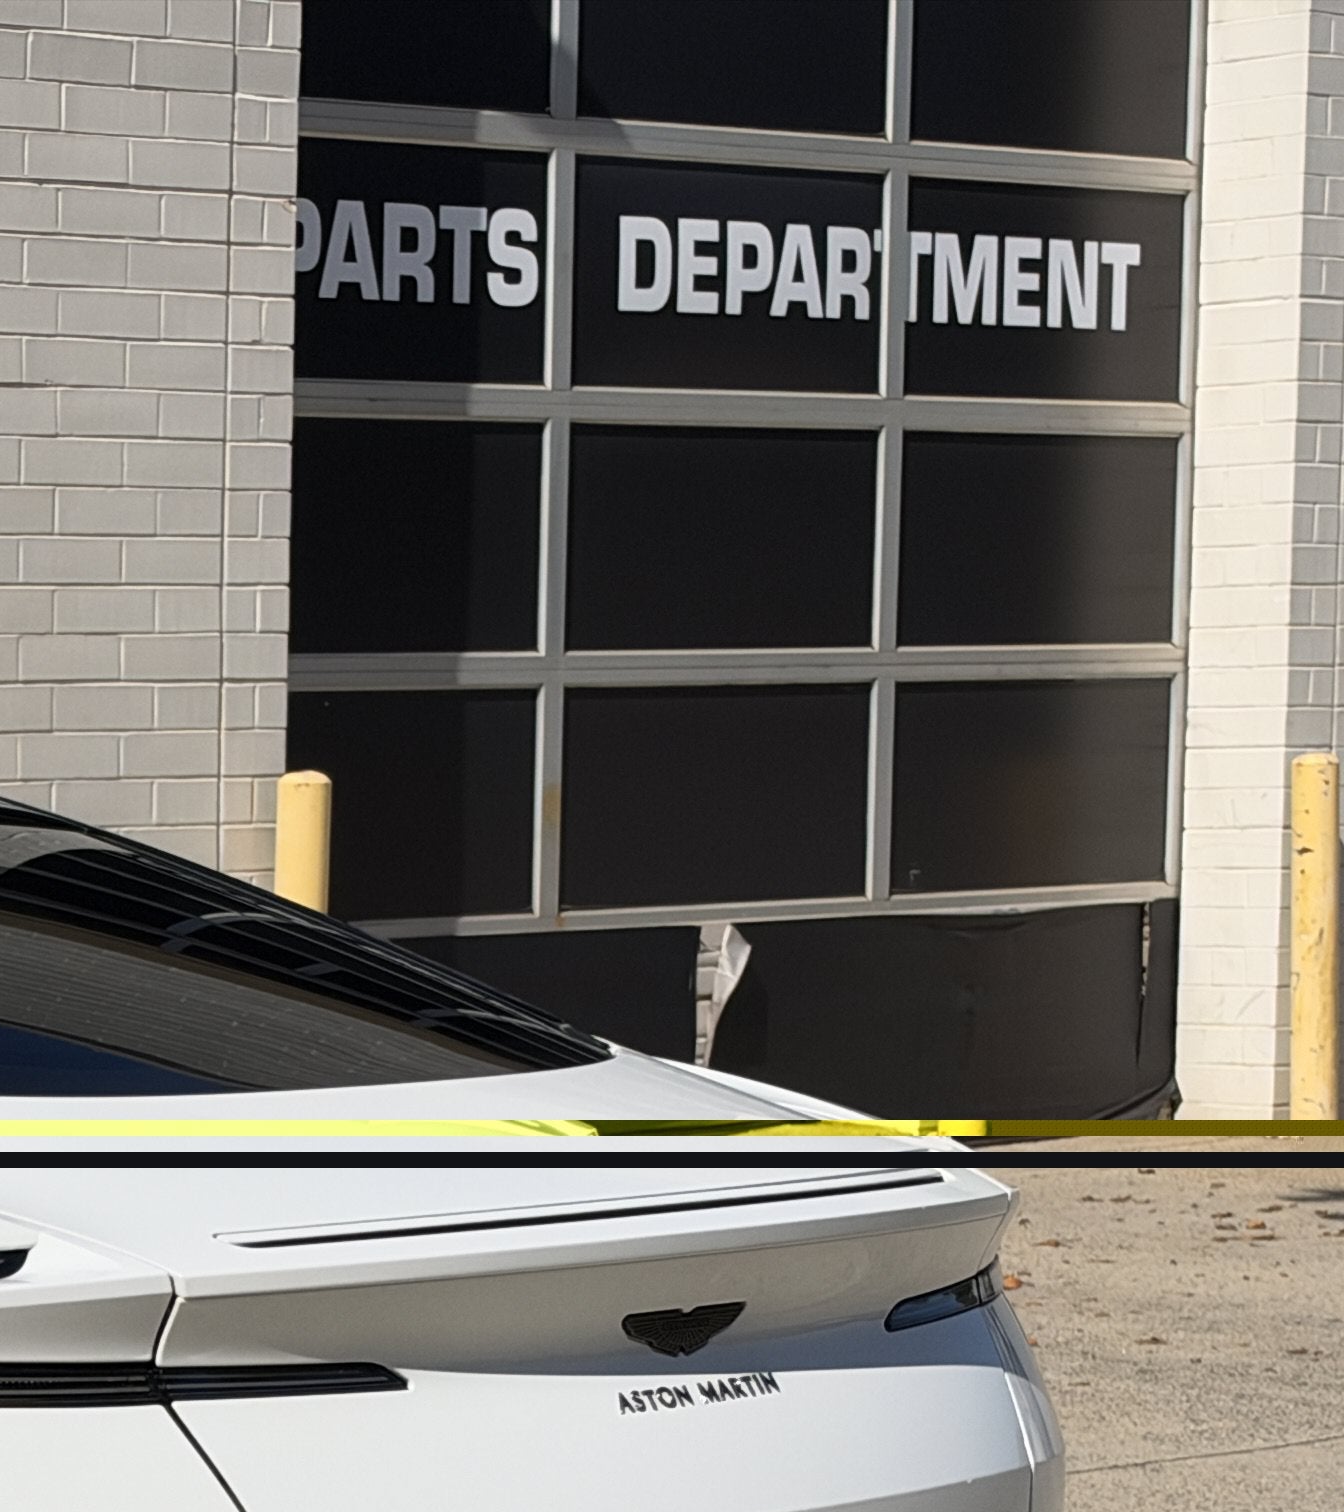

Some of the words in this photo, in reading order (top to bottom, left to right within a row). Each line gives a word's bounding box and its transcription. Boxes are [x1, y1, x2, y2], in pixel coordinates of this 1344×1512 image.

[618, 215, 1141, 331] DEPARTMENT
[618, 1385, 694, 1415] ASTON
[696, 1372, 781, 1404] MARTIN
